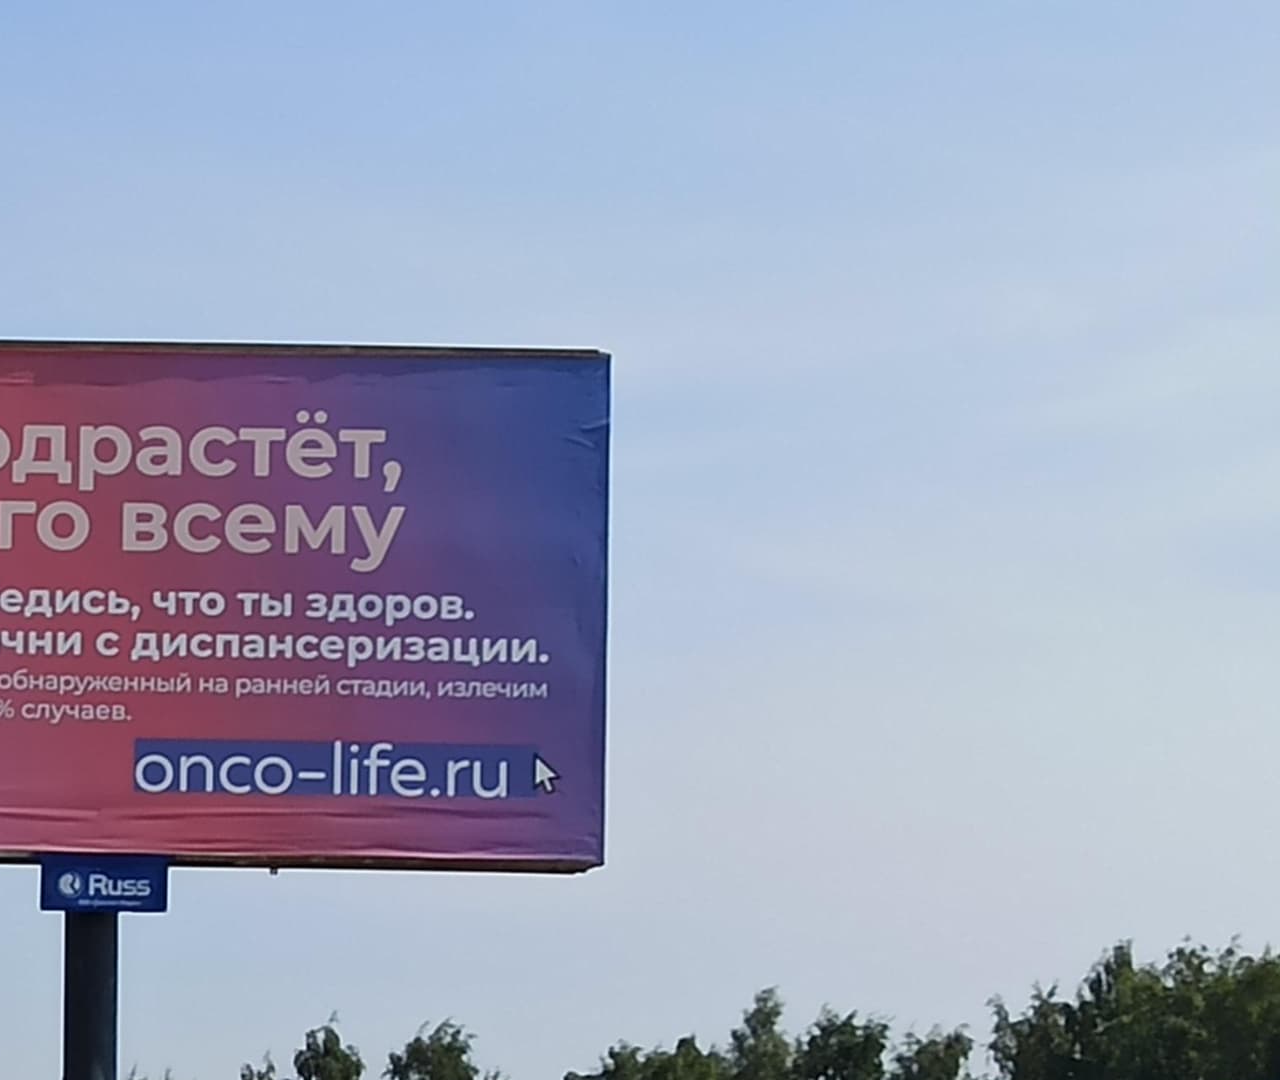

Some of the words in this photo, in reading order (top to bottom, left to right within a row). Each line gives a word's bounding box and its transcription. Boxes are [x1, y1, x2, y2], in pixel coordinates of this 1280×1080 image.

[120, 500, 407, 573] всему
[152, 590, 226, 617] что
[236, 591, 293, 618] ты
[304, 592, 476, 627] здоров.
[95, 631, 120, 657] с
[130, 631, 550, 668] диспансеризации.
[198, 676, 229, 694] на
[234, 675, 331, 698] ранней
[336, 678, 432, 700] стадии,
[436, 680, 549, 699] излечим
[20, 701, 133, 724] случаев.
[133, 739, 509, 798] onco-life.ru
[87, 873, 152, 897] Russ
